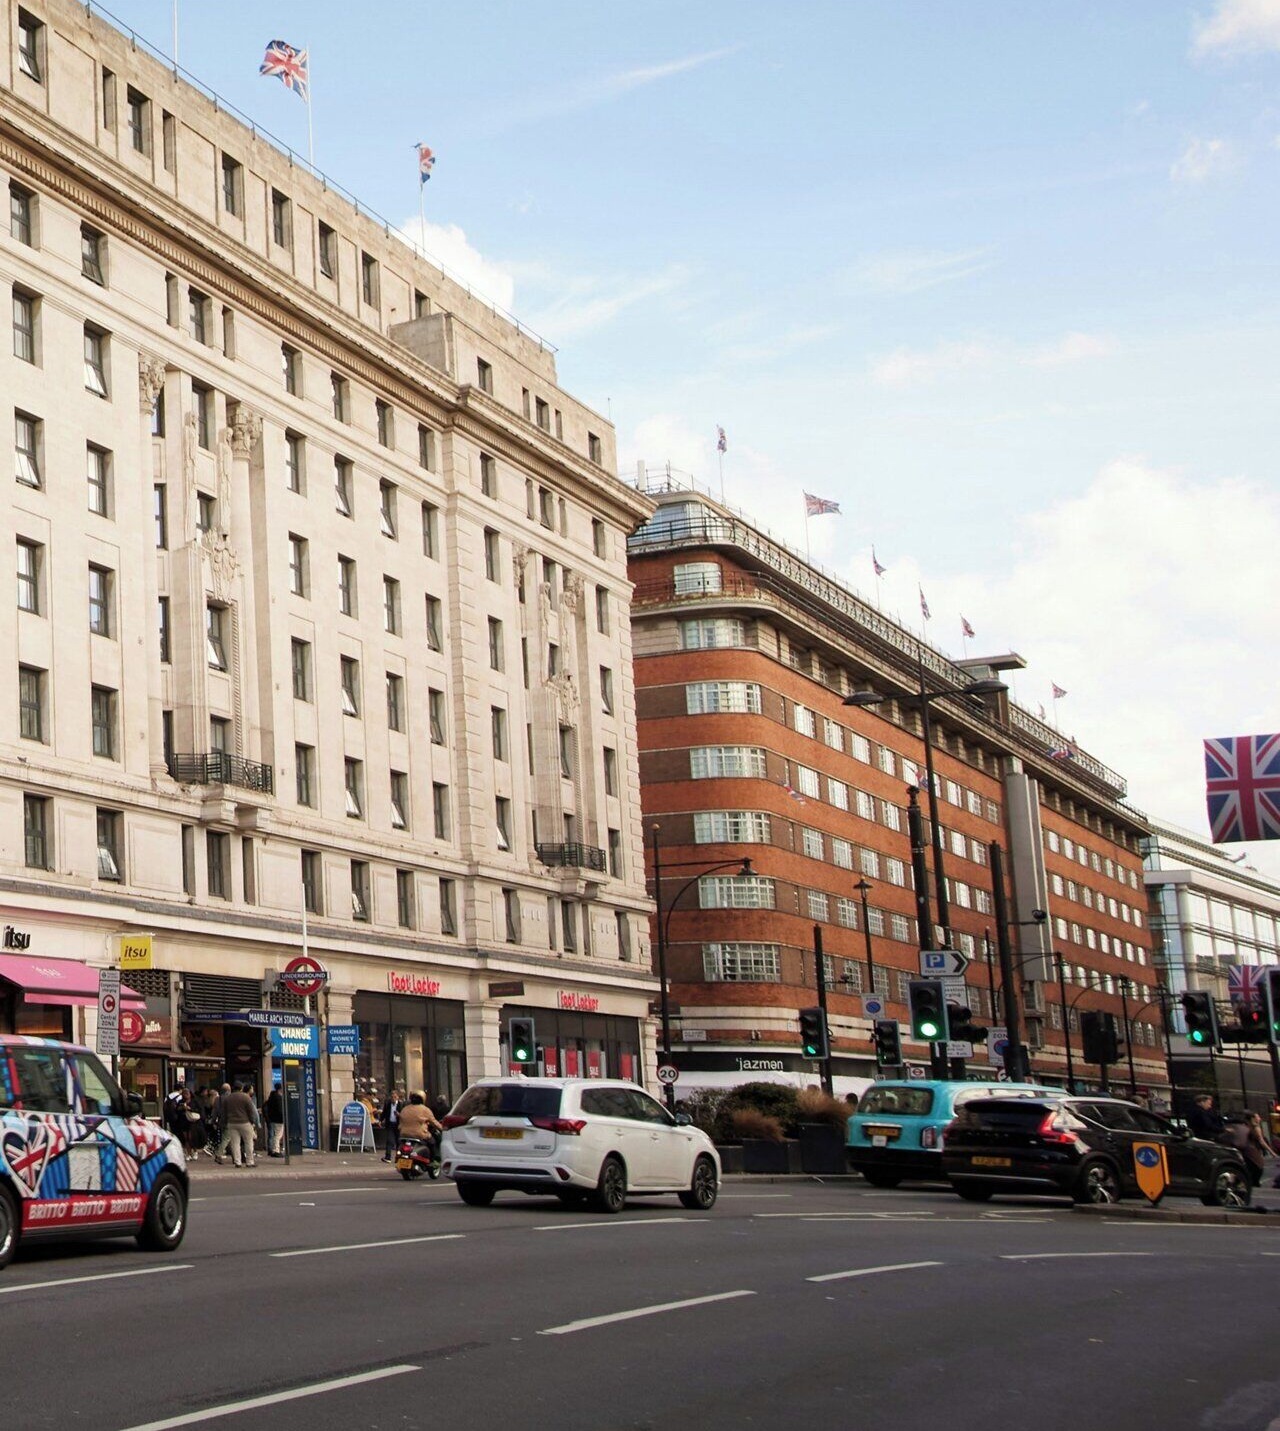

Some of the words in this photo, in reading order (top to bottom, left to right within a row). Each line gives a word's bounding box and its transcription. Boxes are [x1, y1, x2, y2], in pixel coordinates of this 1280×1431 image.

[3, 925, 31, 949] itsu
[124, 946, 147, 957] itsu
[389, 971, 410, 992] Foot
[411, 974, 440, 996] Locker
[559, 990, 576, 1008] Foot
[577, 992, 599, 1011] Locker
[249, 1012, 269, 1023] MARBLE
[270, 1014, 284, 1024] ARCH
[284, 1015, 304, 1025] STATION
[279, 1027, 311, 1040] CHANGE
[281, 1042, 310, 1056] MONEY
[333, 1045, 354, 1053] ATM
[305, 1060, 314, 1105] CHANGE
[660, 1069, 676, 1079] 20
[306, 1108, 316, 1146] MONEY
[29, 1202, 68, 1220] BRITTO
[71, 1200, 106, 1217] BRITTO
[110, 1198, 140, 1214] BRITTO
